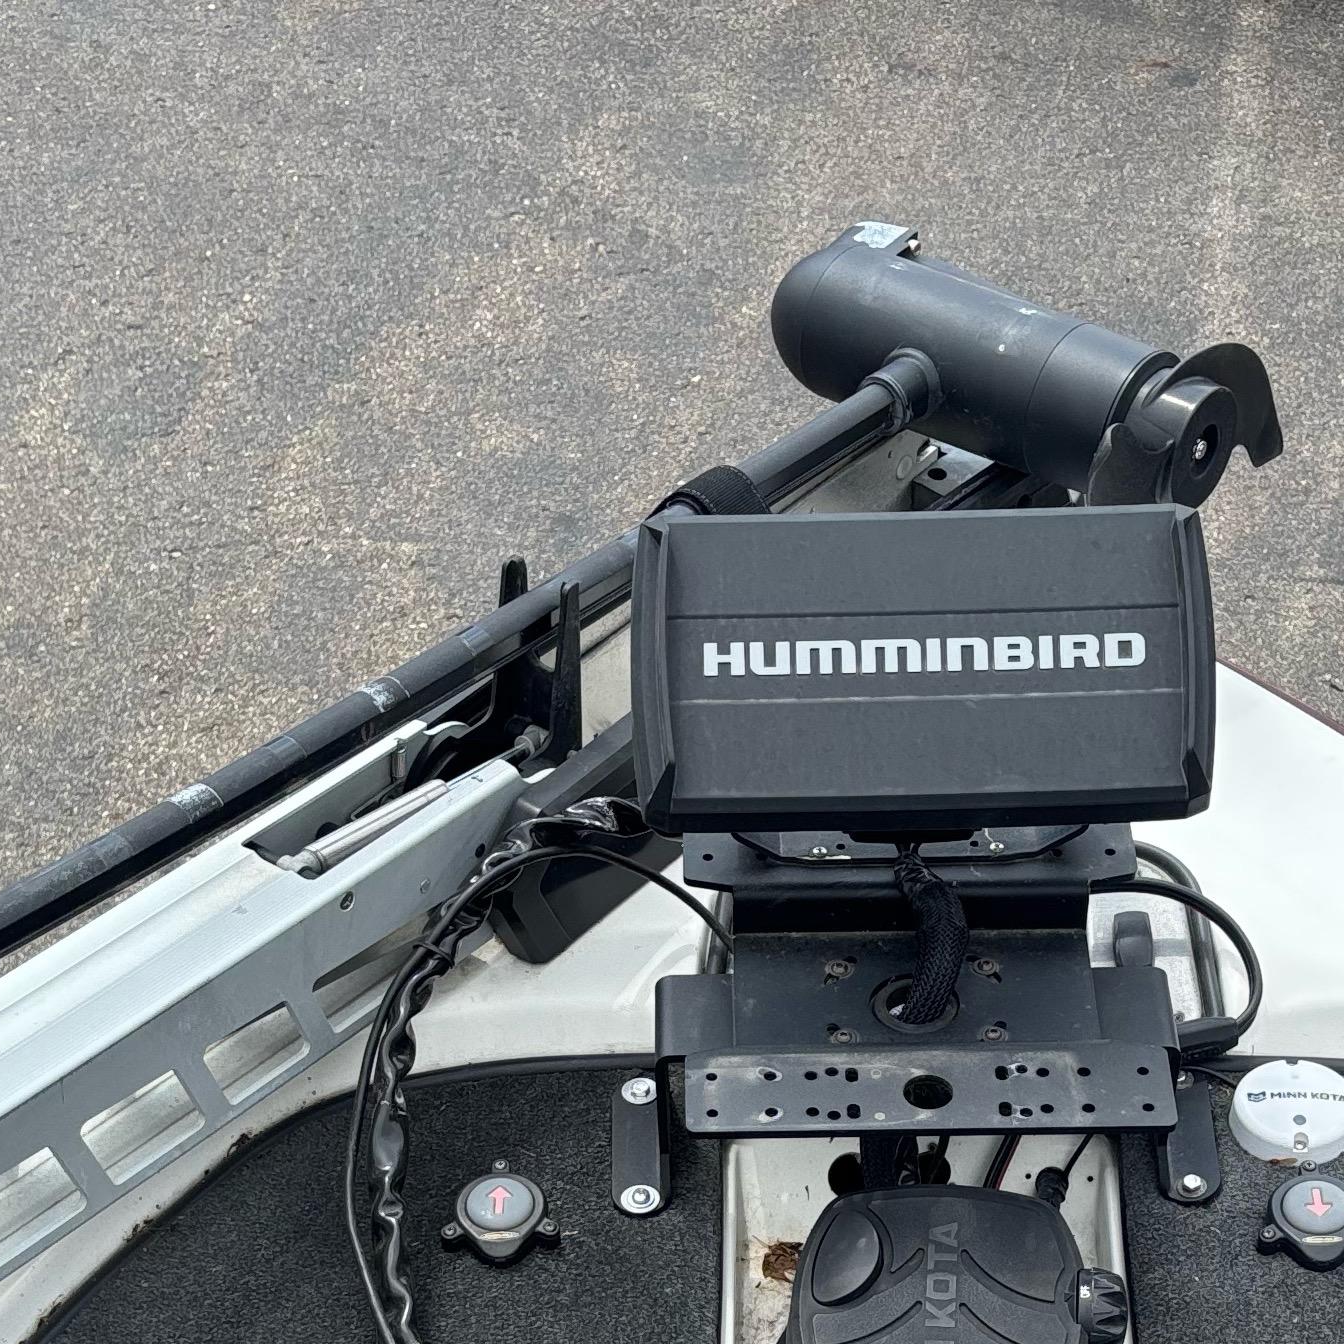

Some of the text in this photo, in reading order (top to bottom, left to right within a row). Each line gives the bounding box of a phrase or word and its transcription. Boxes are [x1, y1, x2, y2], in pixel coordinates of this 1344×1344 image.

[703, 632, 1146, 677] HUMMINBIRD
[1270, 1091, 1307, 1100] MINN
[924, 1222, 958, 1327] KOTA
